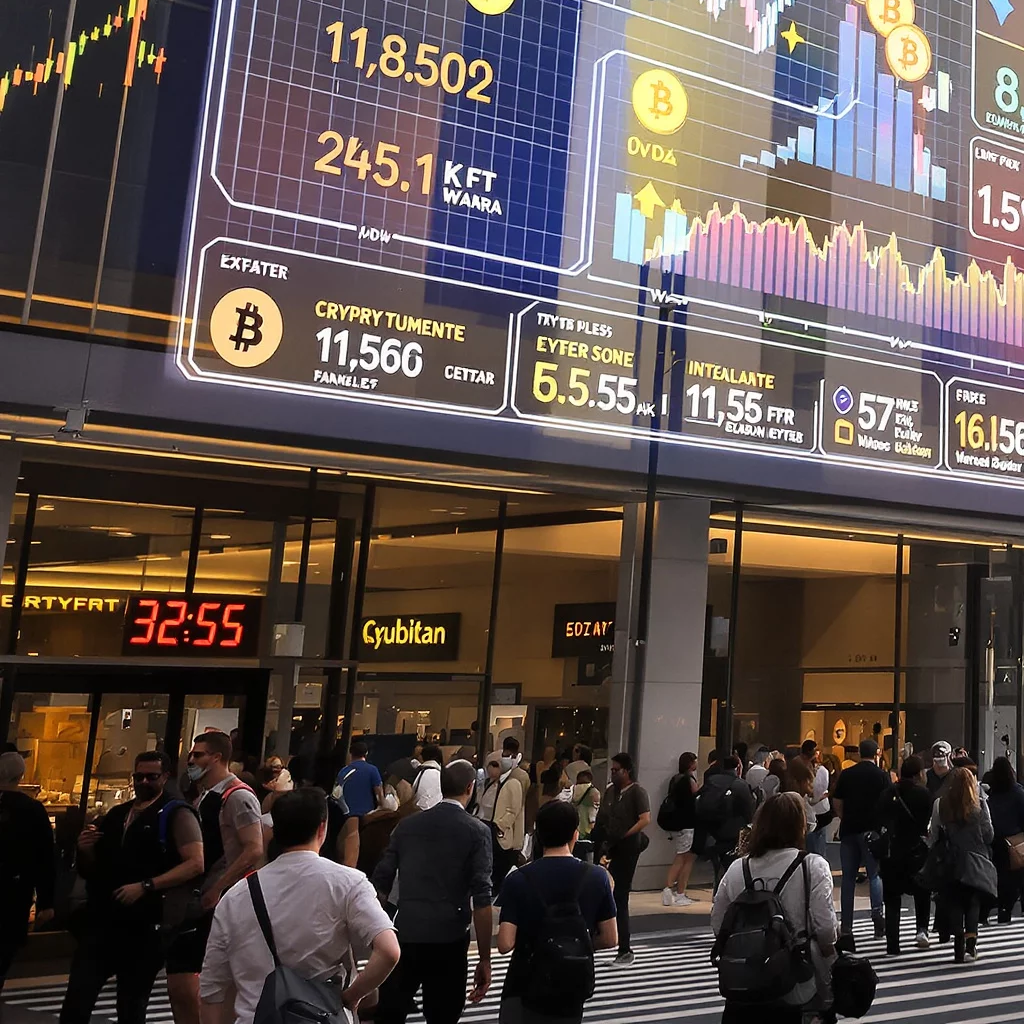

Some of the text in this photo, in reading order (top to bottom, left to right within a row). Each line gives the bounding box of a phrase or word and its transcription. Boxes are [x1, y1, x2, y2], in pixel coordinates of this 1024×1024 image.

[325, 21, 494, 103] 11,8.502
[314, 131, 433, 195] 245.1
[858, 393, 896, 431] 57
